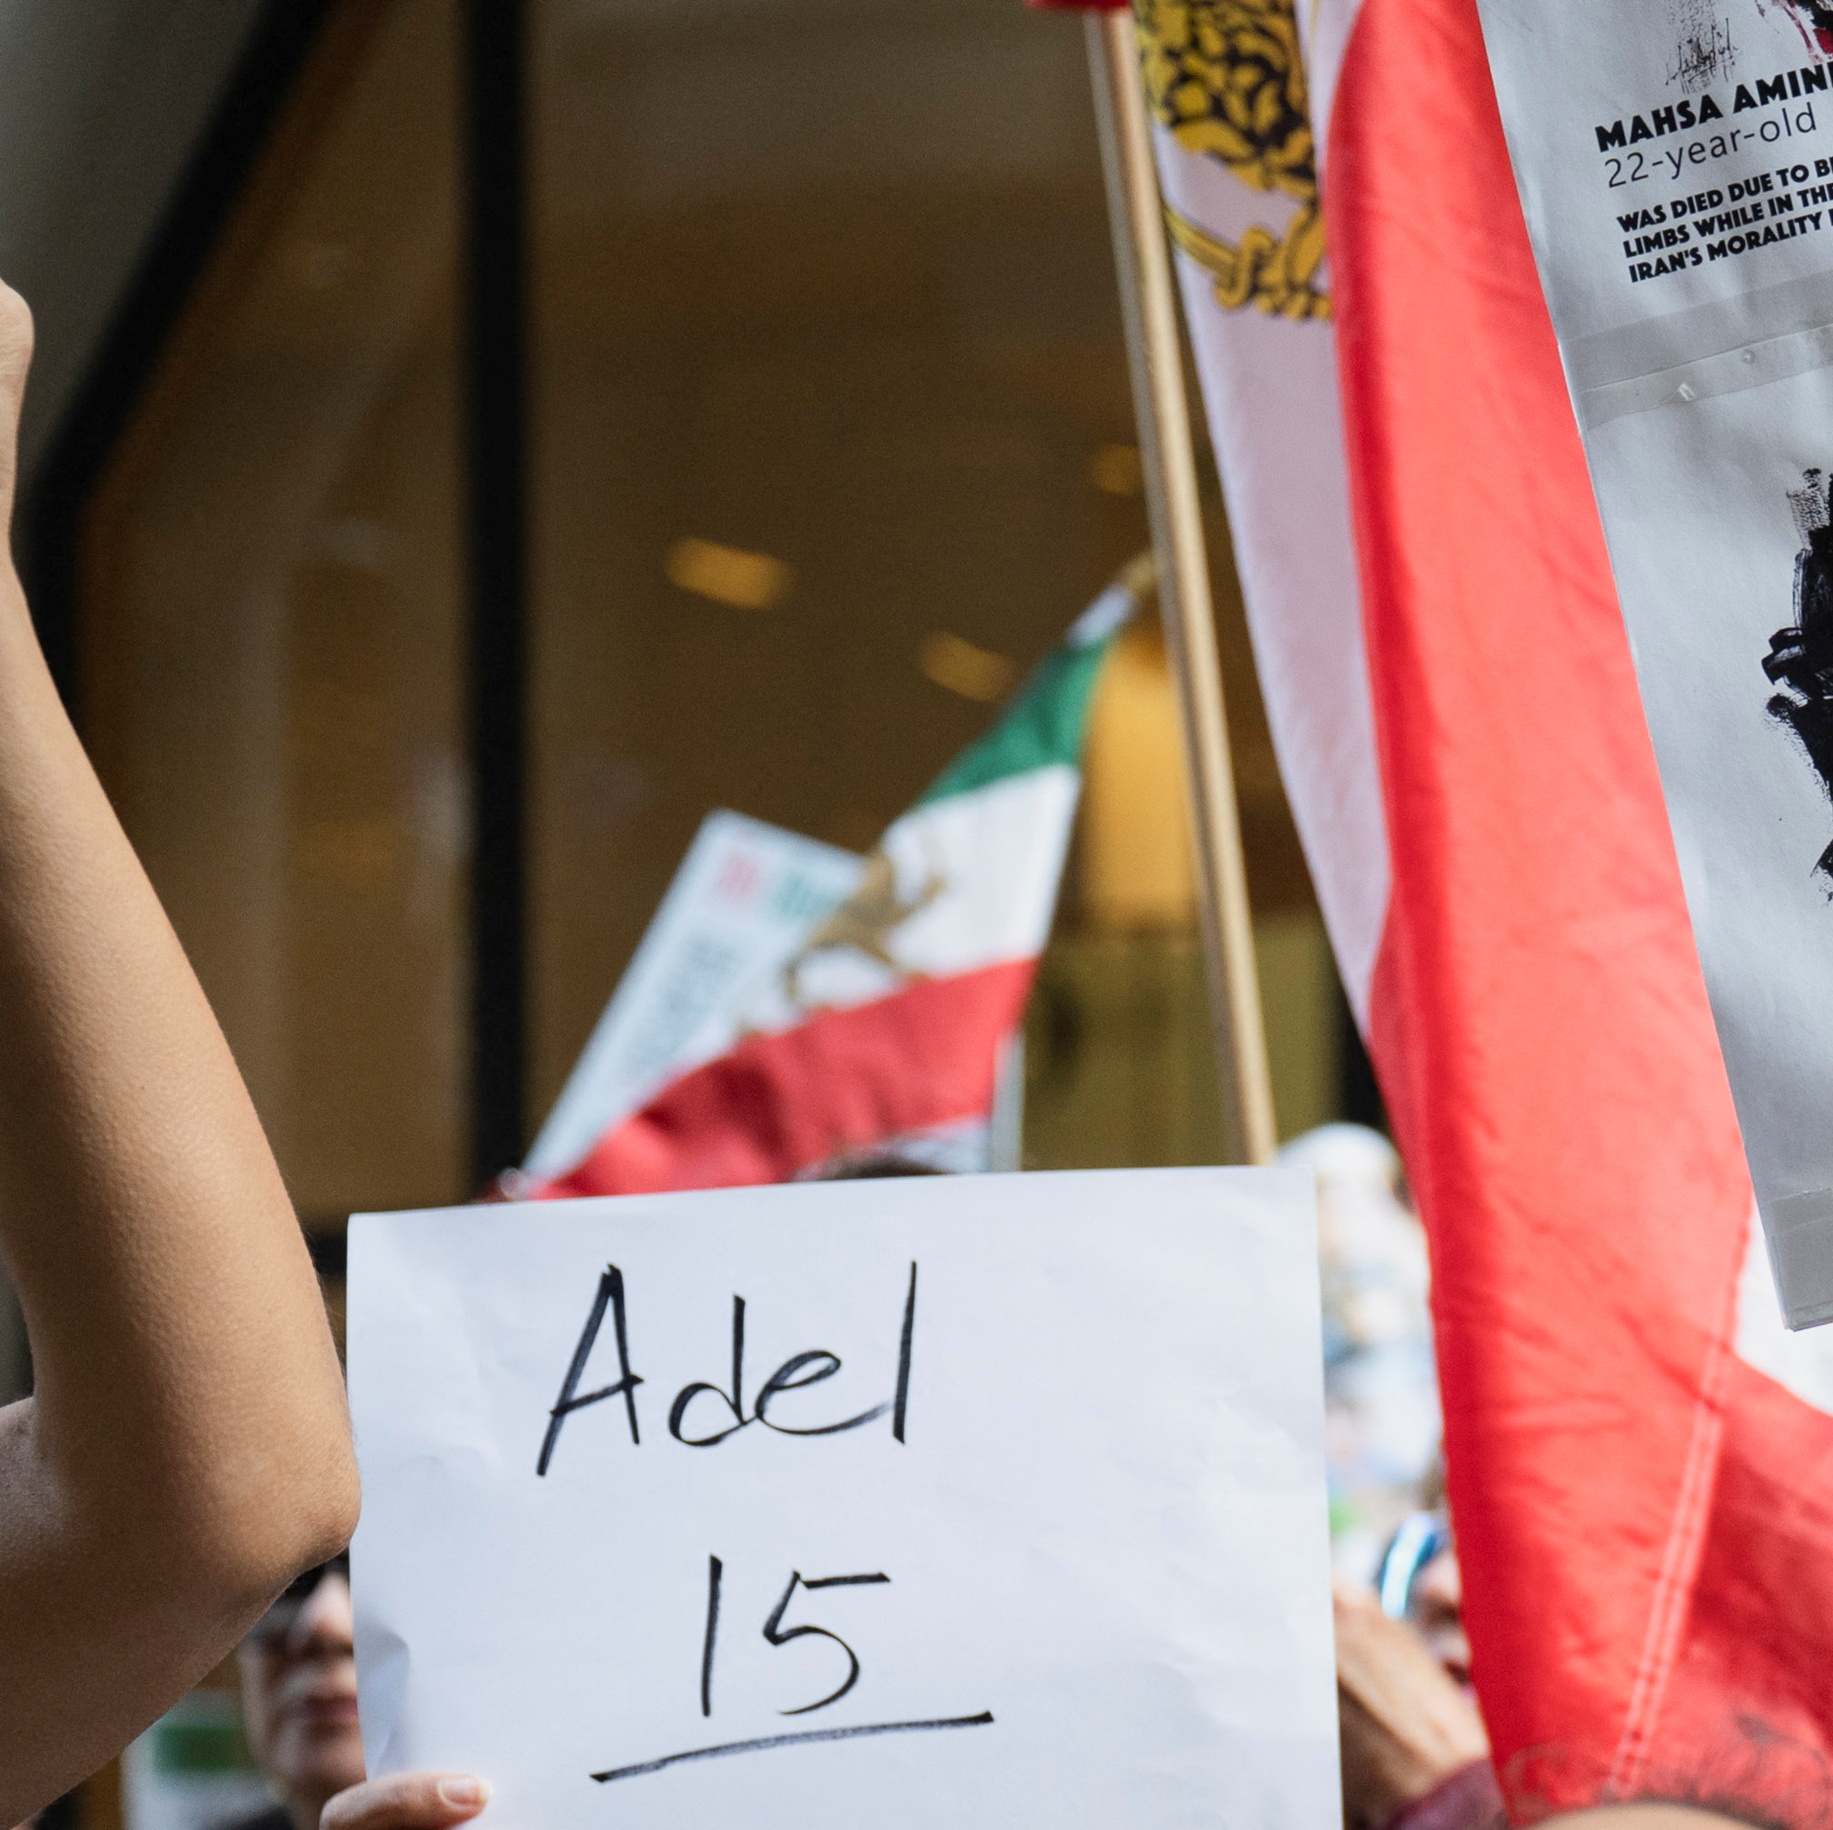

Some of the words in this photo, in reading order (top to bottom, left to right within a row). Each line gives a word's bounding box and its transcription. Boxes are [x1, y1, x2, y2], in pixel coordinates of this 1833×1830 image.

[1595, 94, 1723, 152] MAHSA
[1605, 102, 1817, 188] 22-year-old
[1617, 205, 1666, 232] WAS
[1671, 190, 1723, 218] DIED
[1728, 173, 1773, 202] DUE
[1776, 165, 1809, 186] TO
[1623, 225, 1690, 258] LIMBS
[1693, 202, 1764, 237] WHILE
[1768, 194, 1793, 216] IN
[1629, 247, 1702, 282] IRAN'S
[1707, 213, 1821, 261] MORALITY
[536, 1259, 919, 1476] Adel
[702, 1554, 893, 1717] 15
